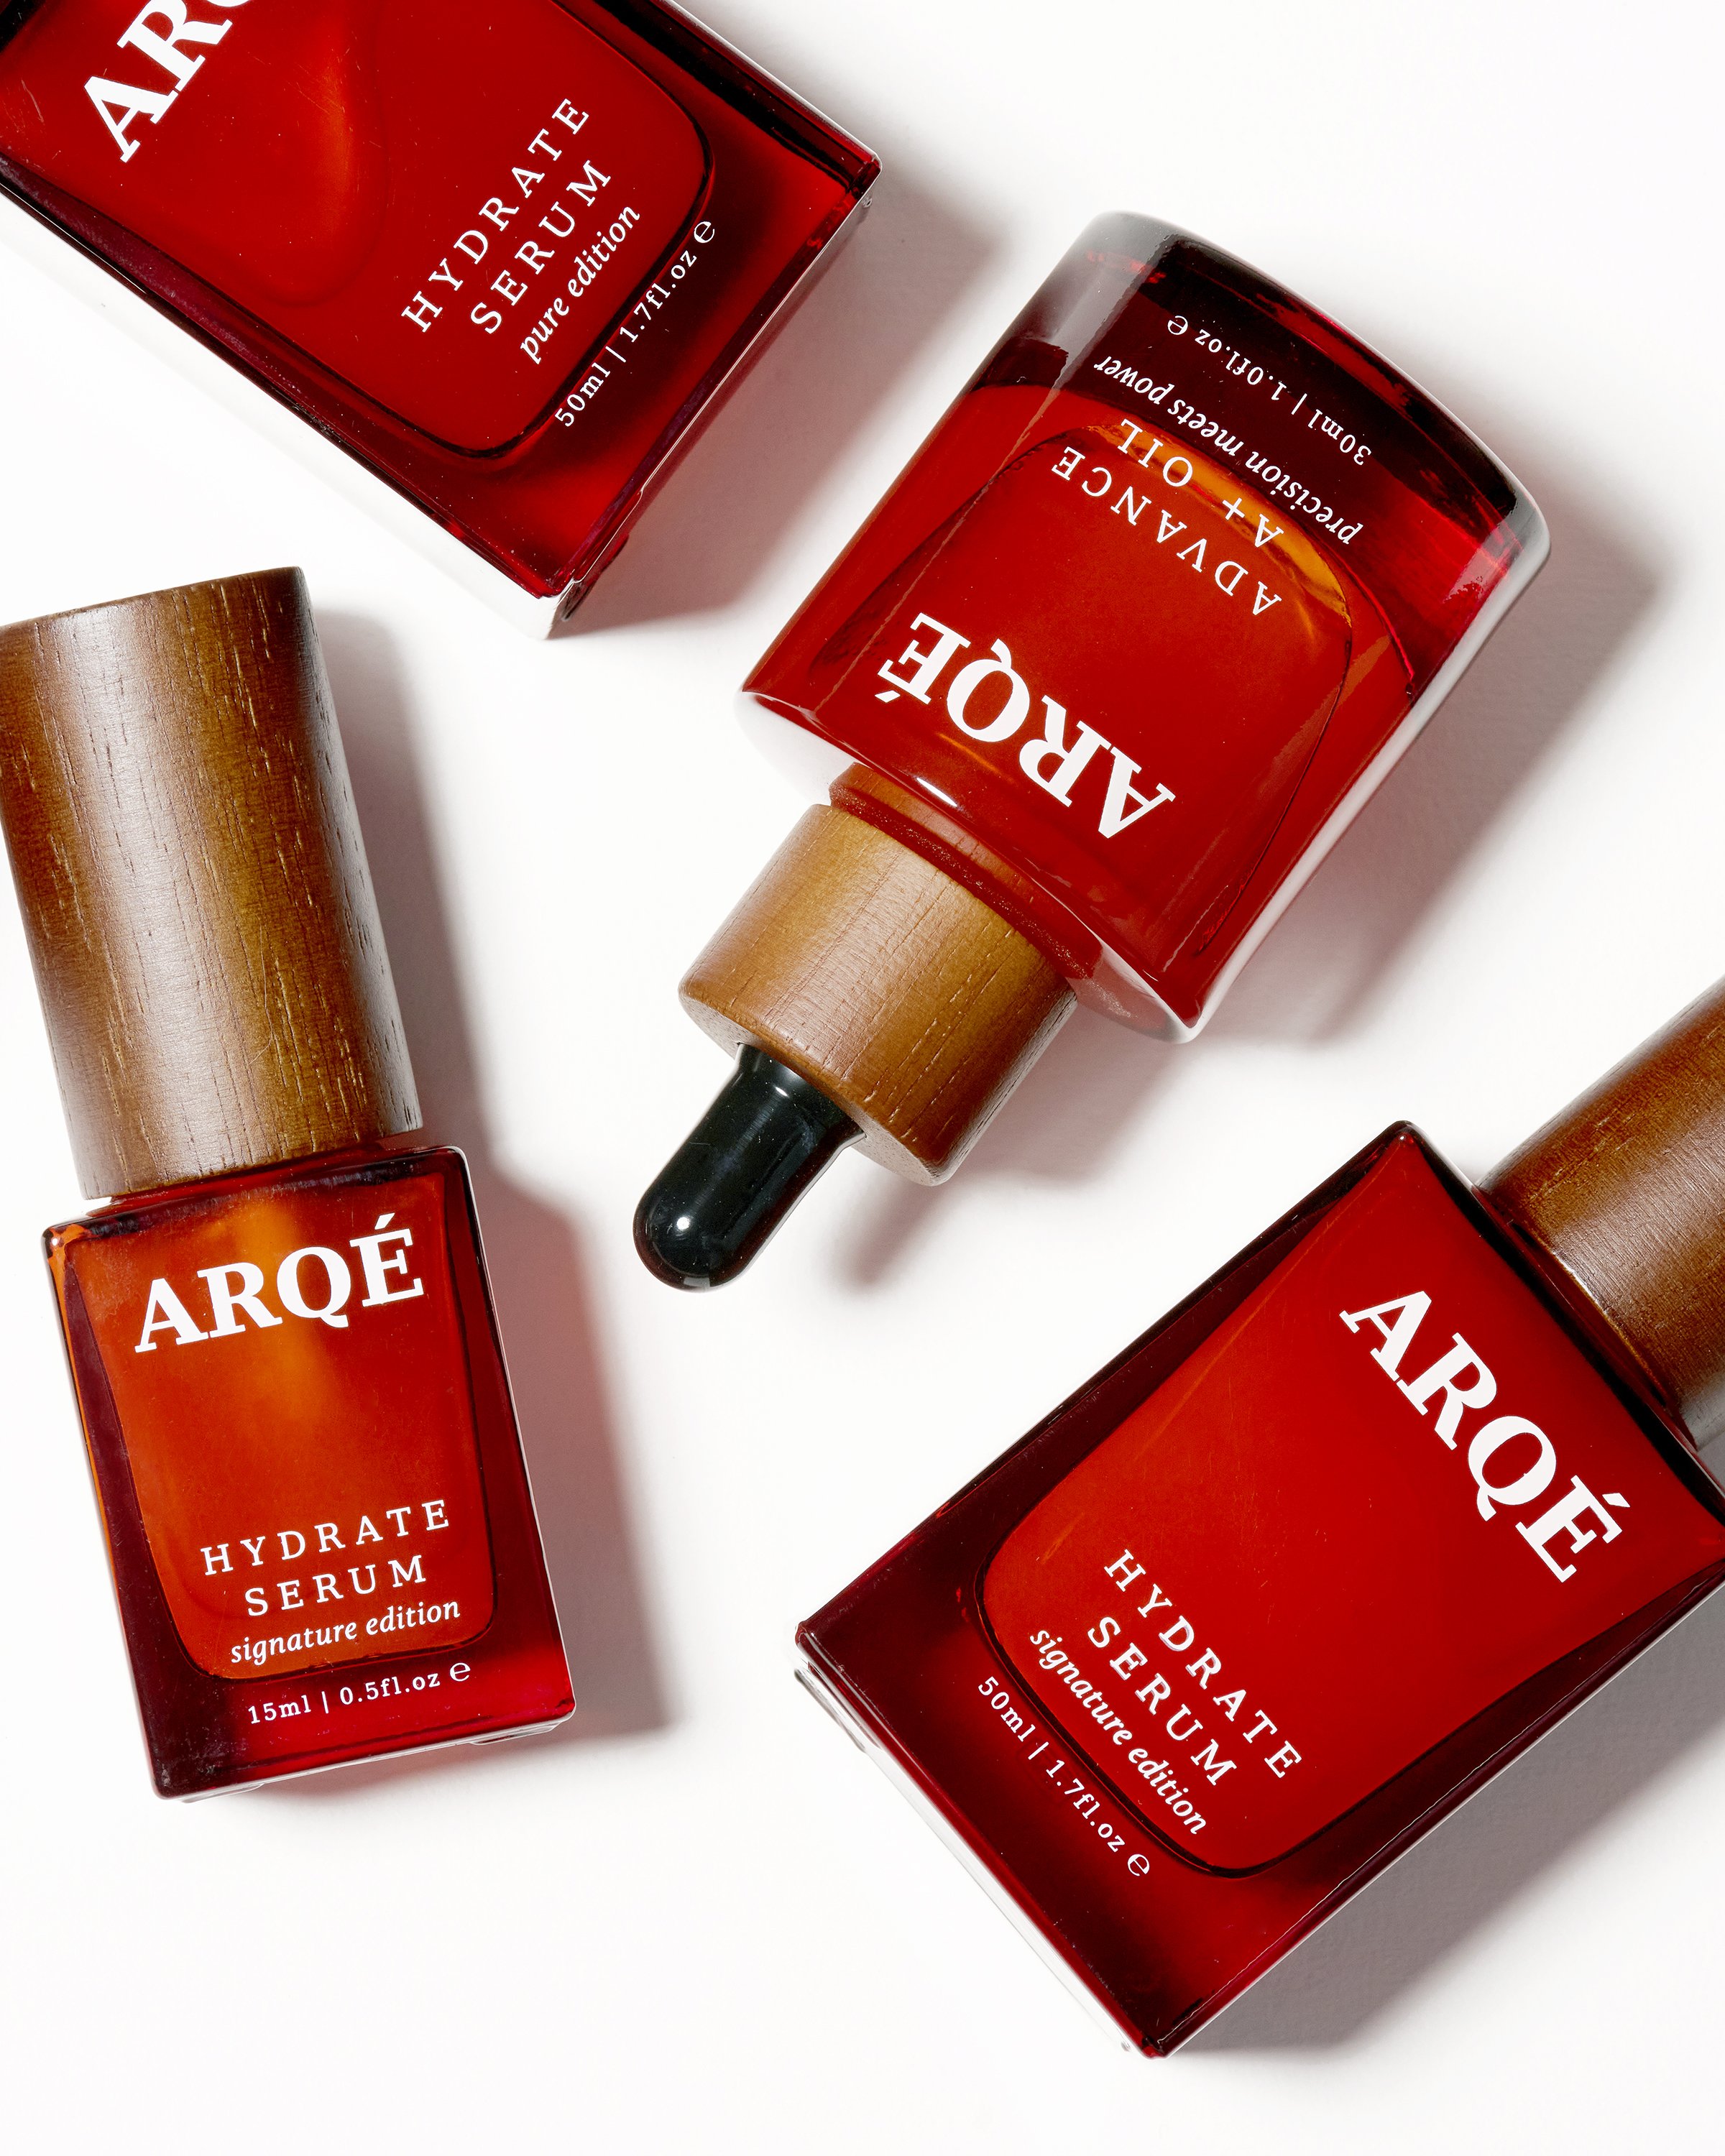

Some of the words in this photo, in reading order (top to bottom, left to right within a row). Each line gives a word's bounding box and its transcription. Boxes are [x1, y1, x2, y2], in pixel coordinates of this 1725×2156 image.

[83, 0, 250, 163] AR
[400, 98, 589, 333] HYDRATE
[470, 160, 612, 334] SERUM
[520, 298, 569, 365] pure
[567, 206, 640, 298] edition
[554, 361, 611, 427] 50ml
[620, 250, 697, 343] 1.7fl.oz
[1093, 356, 1175, 405] power
[1195, 328, 1287, 401] 1.0fl.oz
[1117, 418, 1193, 487] OIL
[1167, 399, 1244, 456] meets
[1245, 451, 1364, 545] precision
[1307, 408, 1372, 466] 30ml
[1051, 446, 1282, 616] ADVANCE
[1222, 497, 1284, 548] A+
[874, 612, 1177, 839] ARQÉ
[134, 1212, 424, 1353] ARQÉ
[1338, 1290, 1631, 1583] ARQÉ
[200, 1499, 449, 1576] HYDRATE
[244, 1554, 426, 1616] SERUM
[231, 1621, 357, 1666] signature
[365, 1601, 461, 1636] edition
[248, 1695, 311, 1724] 15ml
[339, 1672, 441, 1705] 0.5fl.oz
[1087, 1616, 1238, 1786] SERUM
[1103, 1549, 1302, 1779] HYDRATE
[978, 1676, 1036, 1742] 50ml
[1046, 1759, 1126, 1853] 1.7fl.oz
[1029, 1630, 1133, 1746] signature
[1128, 1748, 1207, 1835] edition
